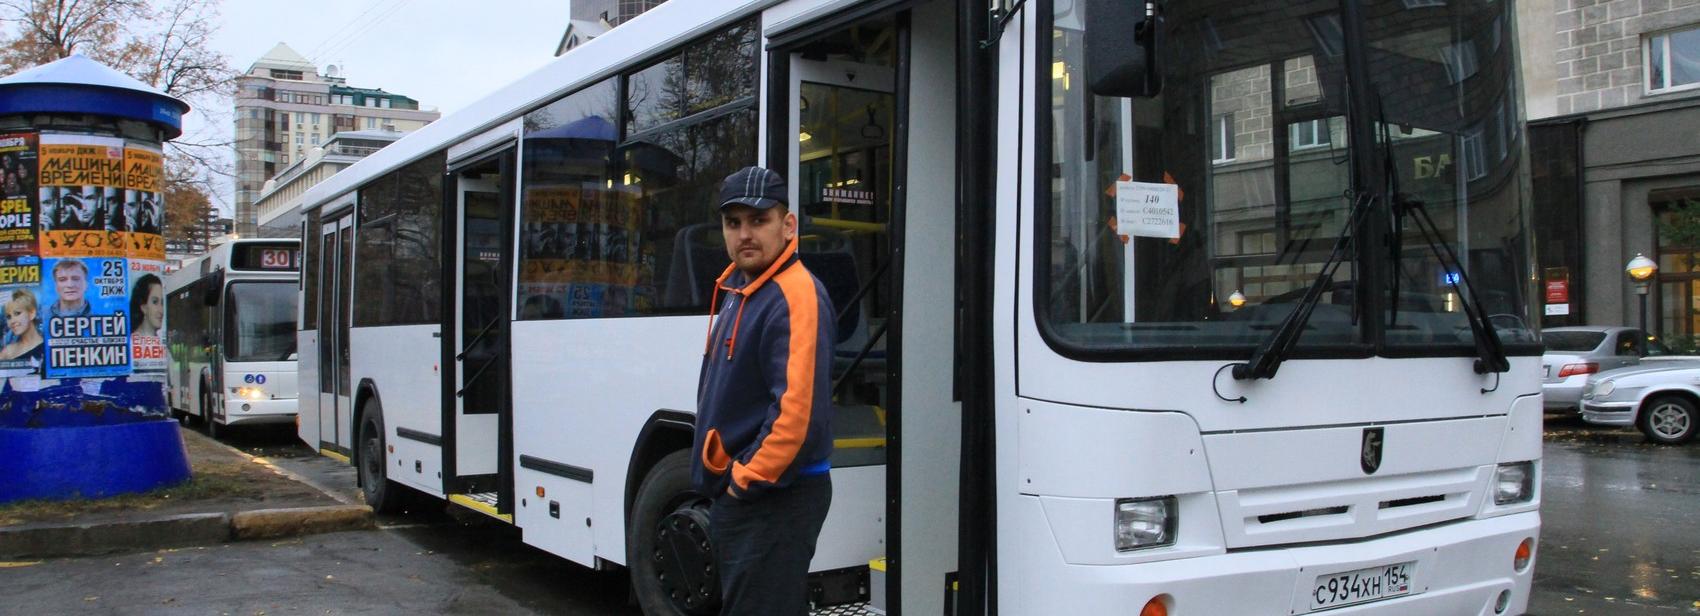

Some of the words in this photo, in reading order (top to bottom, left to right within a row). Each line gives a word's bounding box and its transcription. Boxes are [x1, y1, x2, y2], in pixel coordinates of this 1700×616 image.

[42, 158, 121, 172] МАШИНА
[41, 171, 122, 185] ВРЕМЕНИ
[1145, 194, 1160, 204] 140
[0, 213, 31, 228] OPLE
[263, 250, 288, 267] 30
[0, 265, 39, 283] ЕРИЯ
[102, 261, 123, 277] 25
[94, 278, 125, 286] ОКТЯБРЯ
[101, 285, 125, 297] ДКЖ
[50, 312, 126, 338] СЕРГЕЙ
[51, 346, 127, 368] ПЕНКИН
[1316, 574, 1381, 604] С934ХН
[1384, 565, 1409, 586] 154
